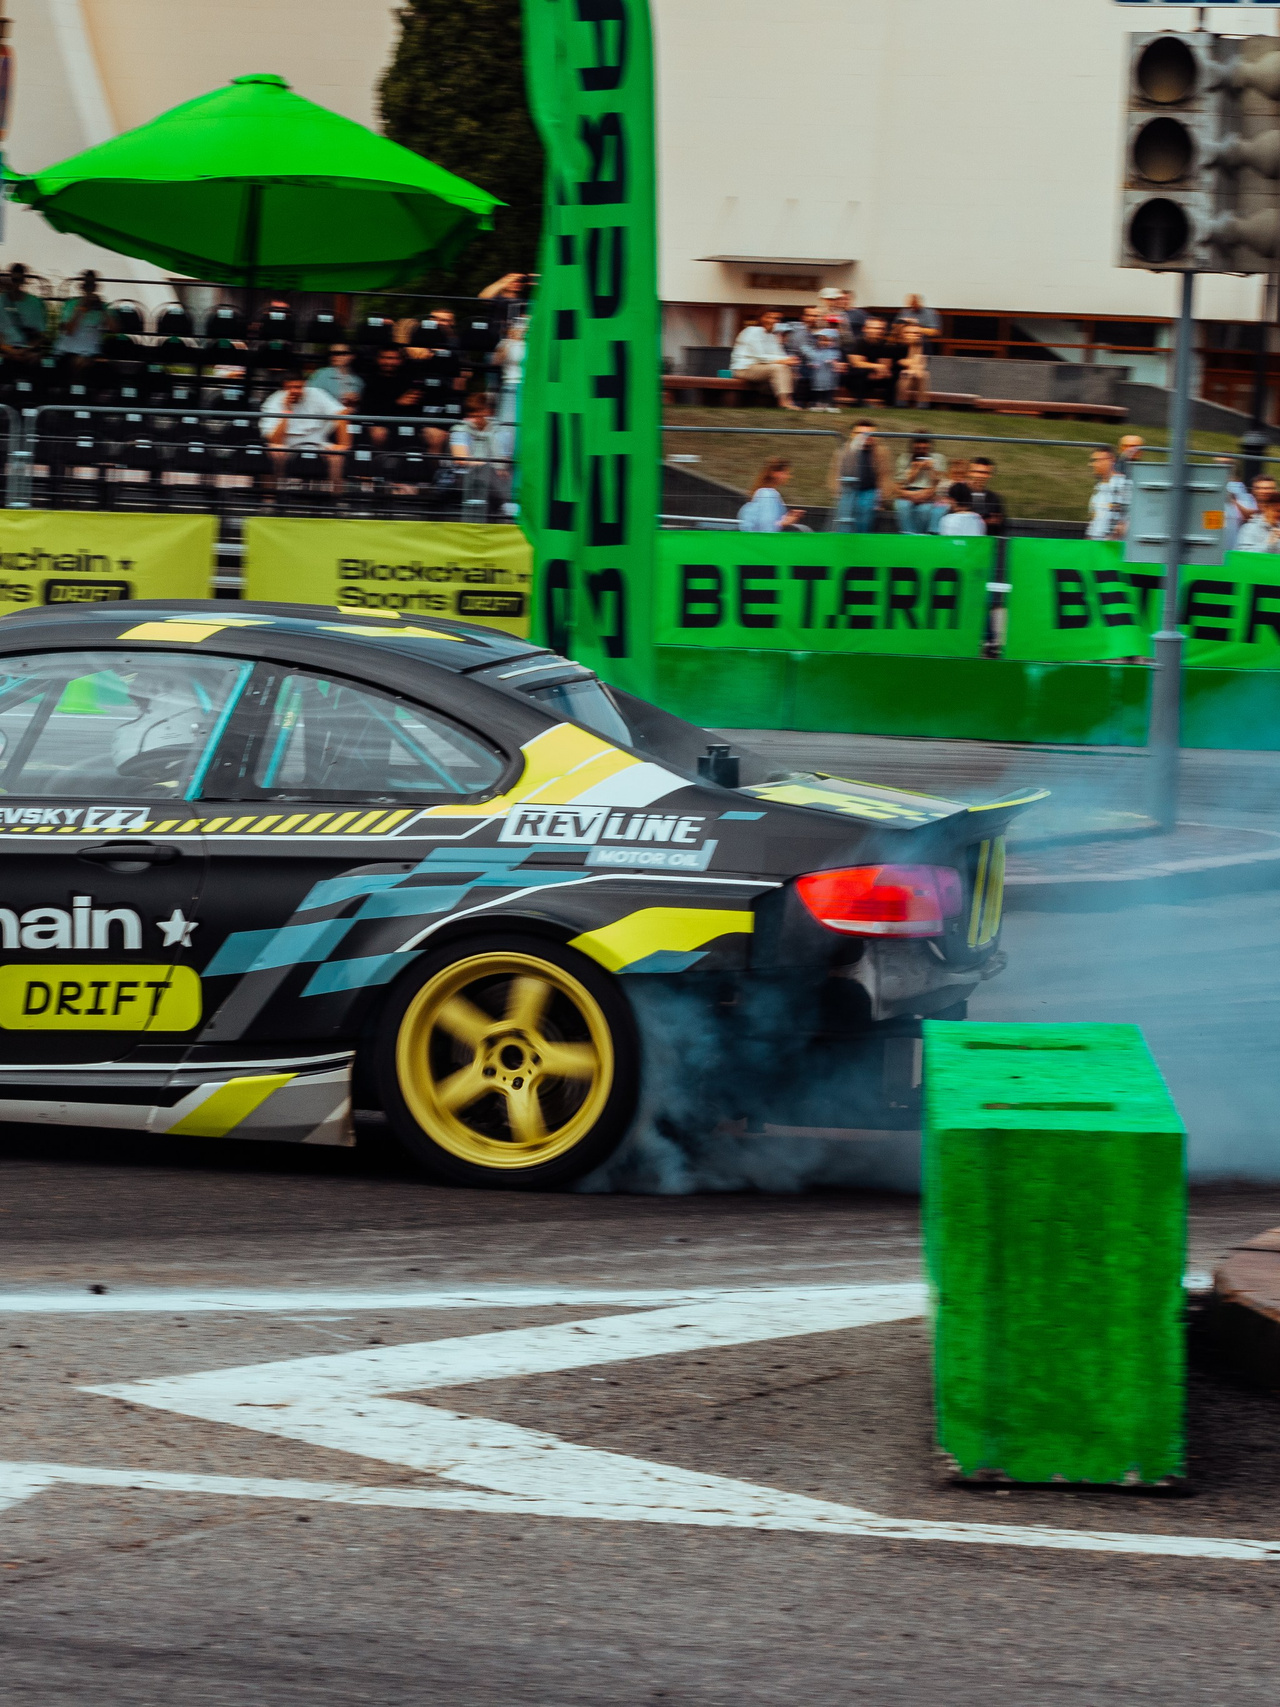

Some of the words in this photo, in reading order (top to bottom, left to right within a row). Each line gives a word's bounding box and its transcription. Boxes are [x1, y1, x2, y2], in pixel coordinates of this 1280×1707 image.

[337, 559, 513, 584] Blockchain
[338, 586, 448, 610] Sports
[595, 850, 665, 865] MOTOR
[674, 853, 701, 867] OIL
[21, 980, 172, 1016] DRIFT
